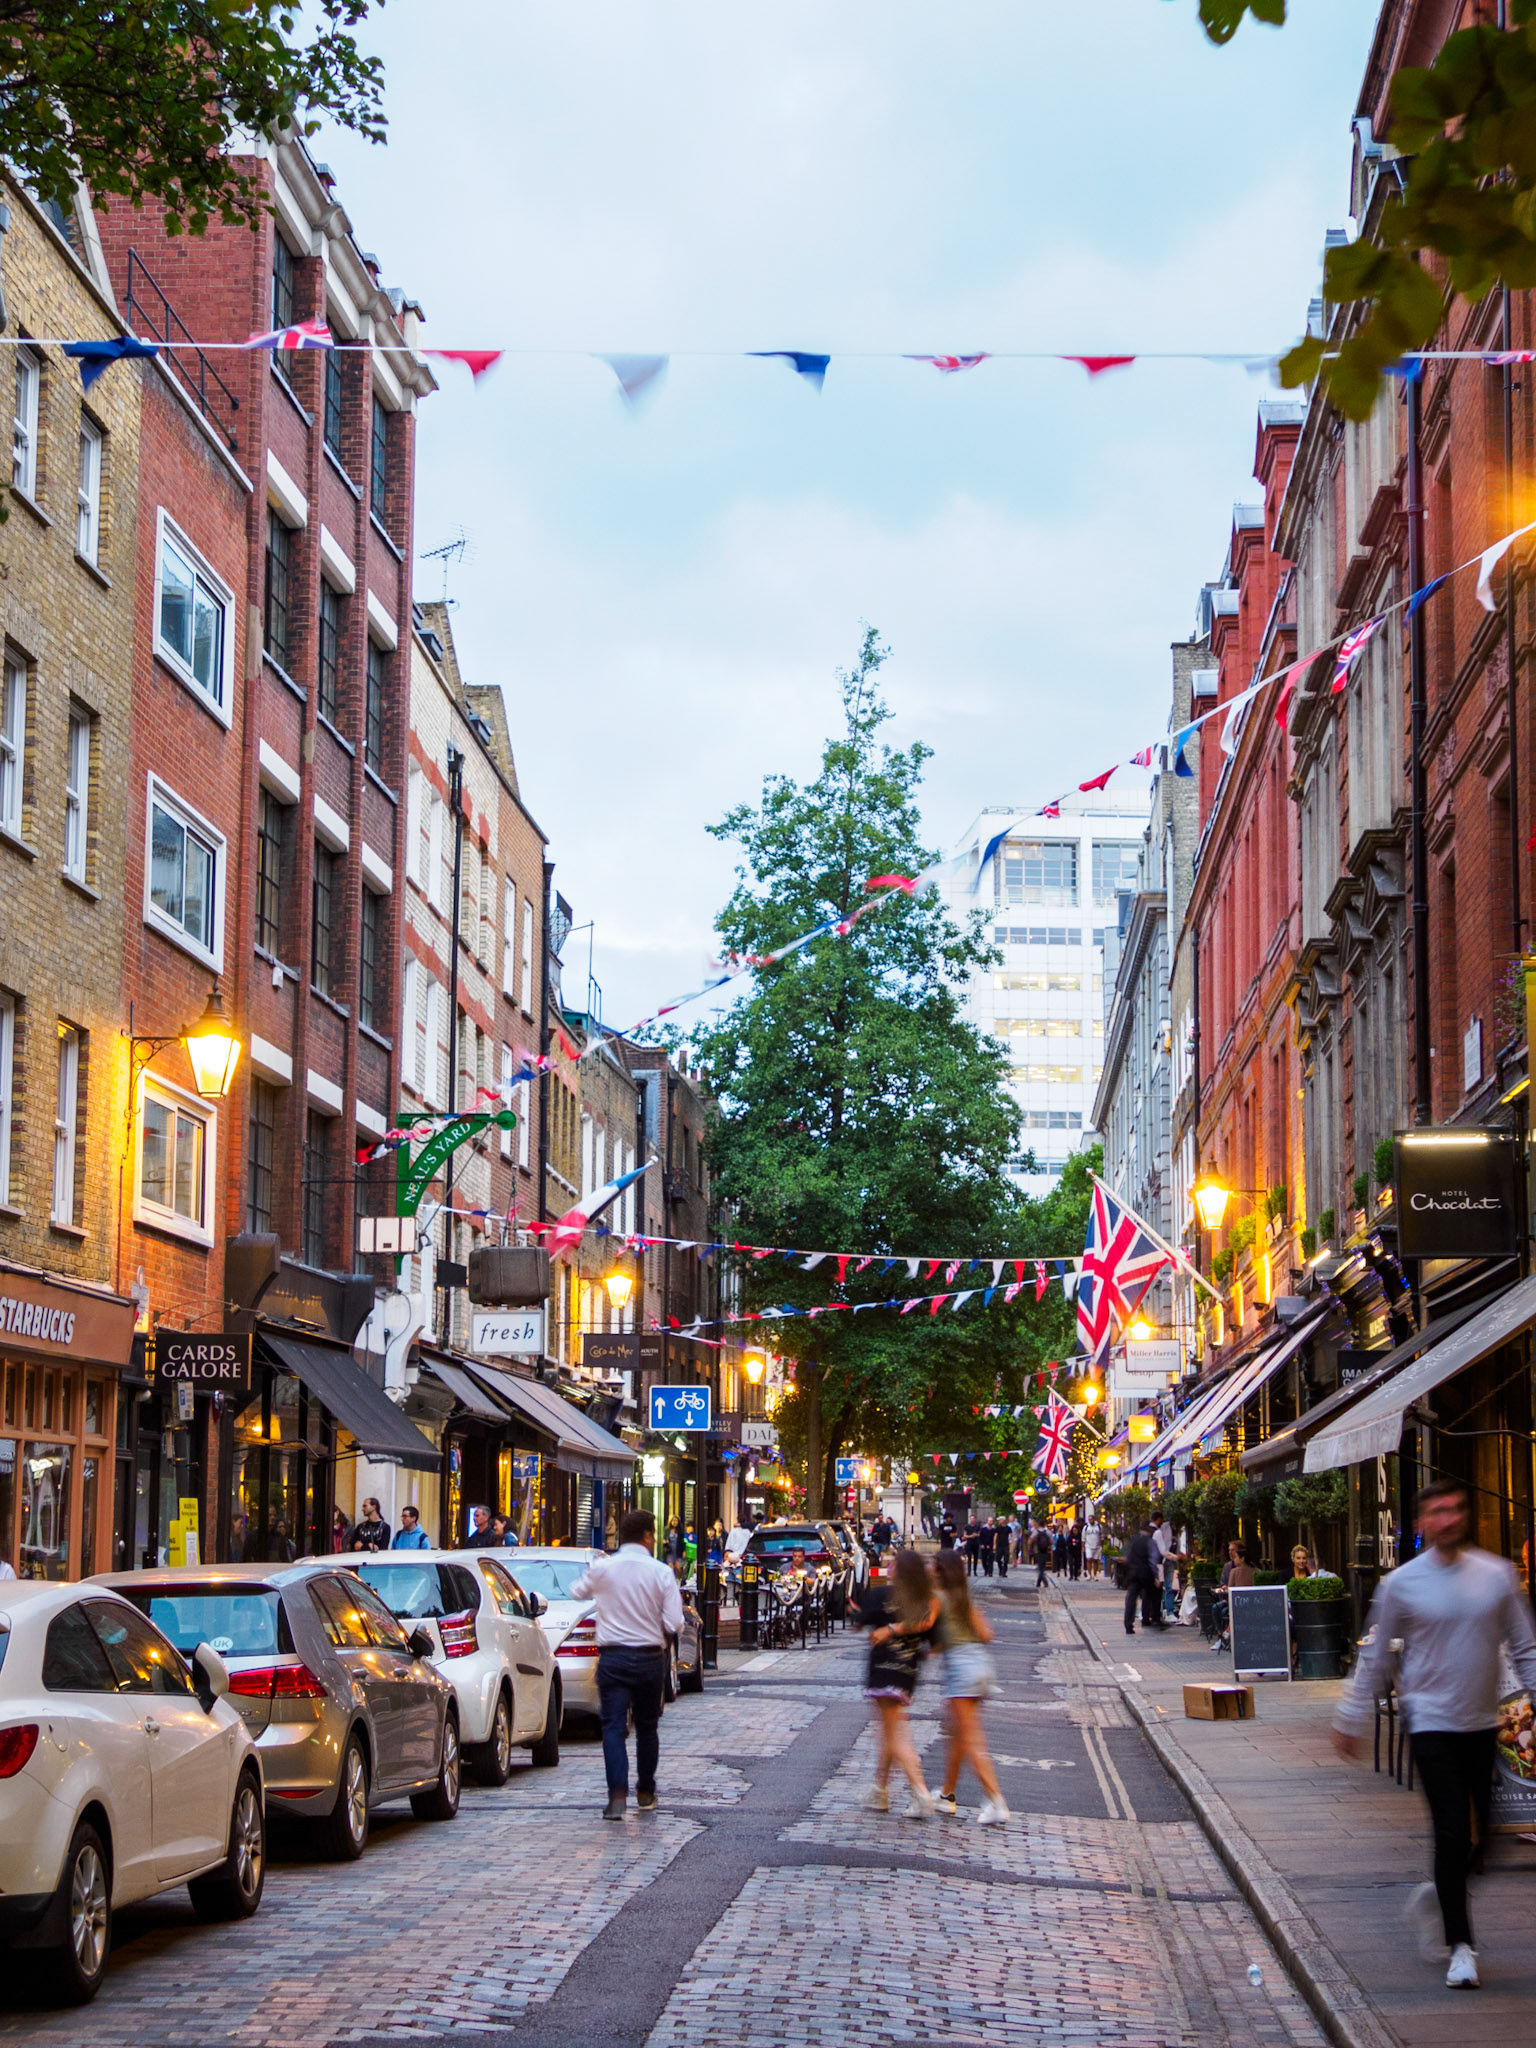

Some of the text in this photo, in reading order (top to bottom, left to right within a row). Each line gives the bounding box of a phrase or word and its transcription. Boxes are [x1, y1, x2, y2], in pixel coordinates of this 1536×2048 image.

[404, 1122, 471, 1203] NEAL'S YARD
[0, 1296, 76, 1344] STARBUCKS
[480, 1322, 535, 1345] fresh
[168, 1345, 236, 1361] CARDS
[589, 1345, 608, 1358] Coco
[617, 1344, 634, 1359] Mer
[1130, 1349, 1177, 1357] Miller Harris
[161, 1362, 241, 1378] GALORE
[745, 1566, 757, 1582] H
[213, 1640, 229, 1648] UK
